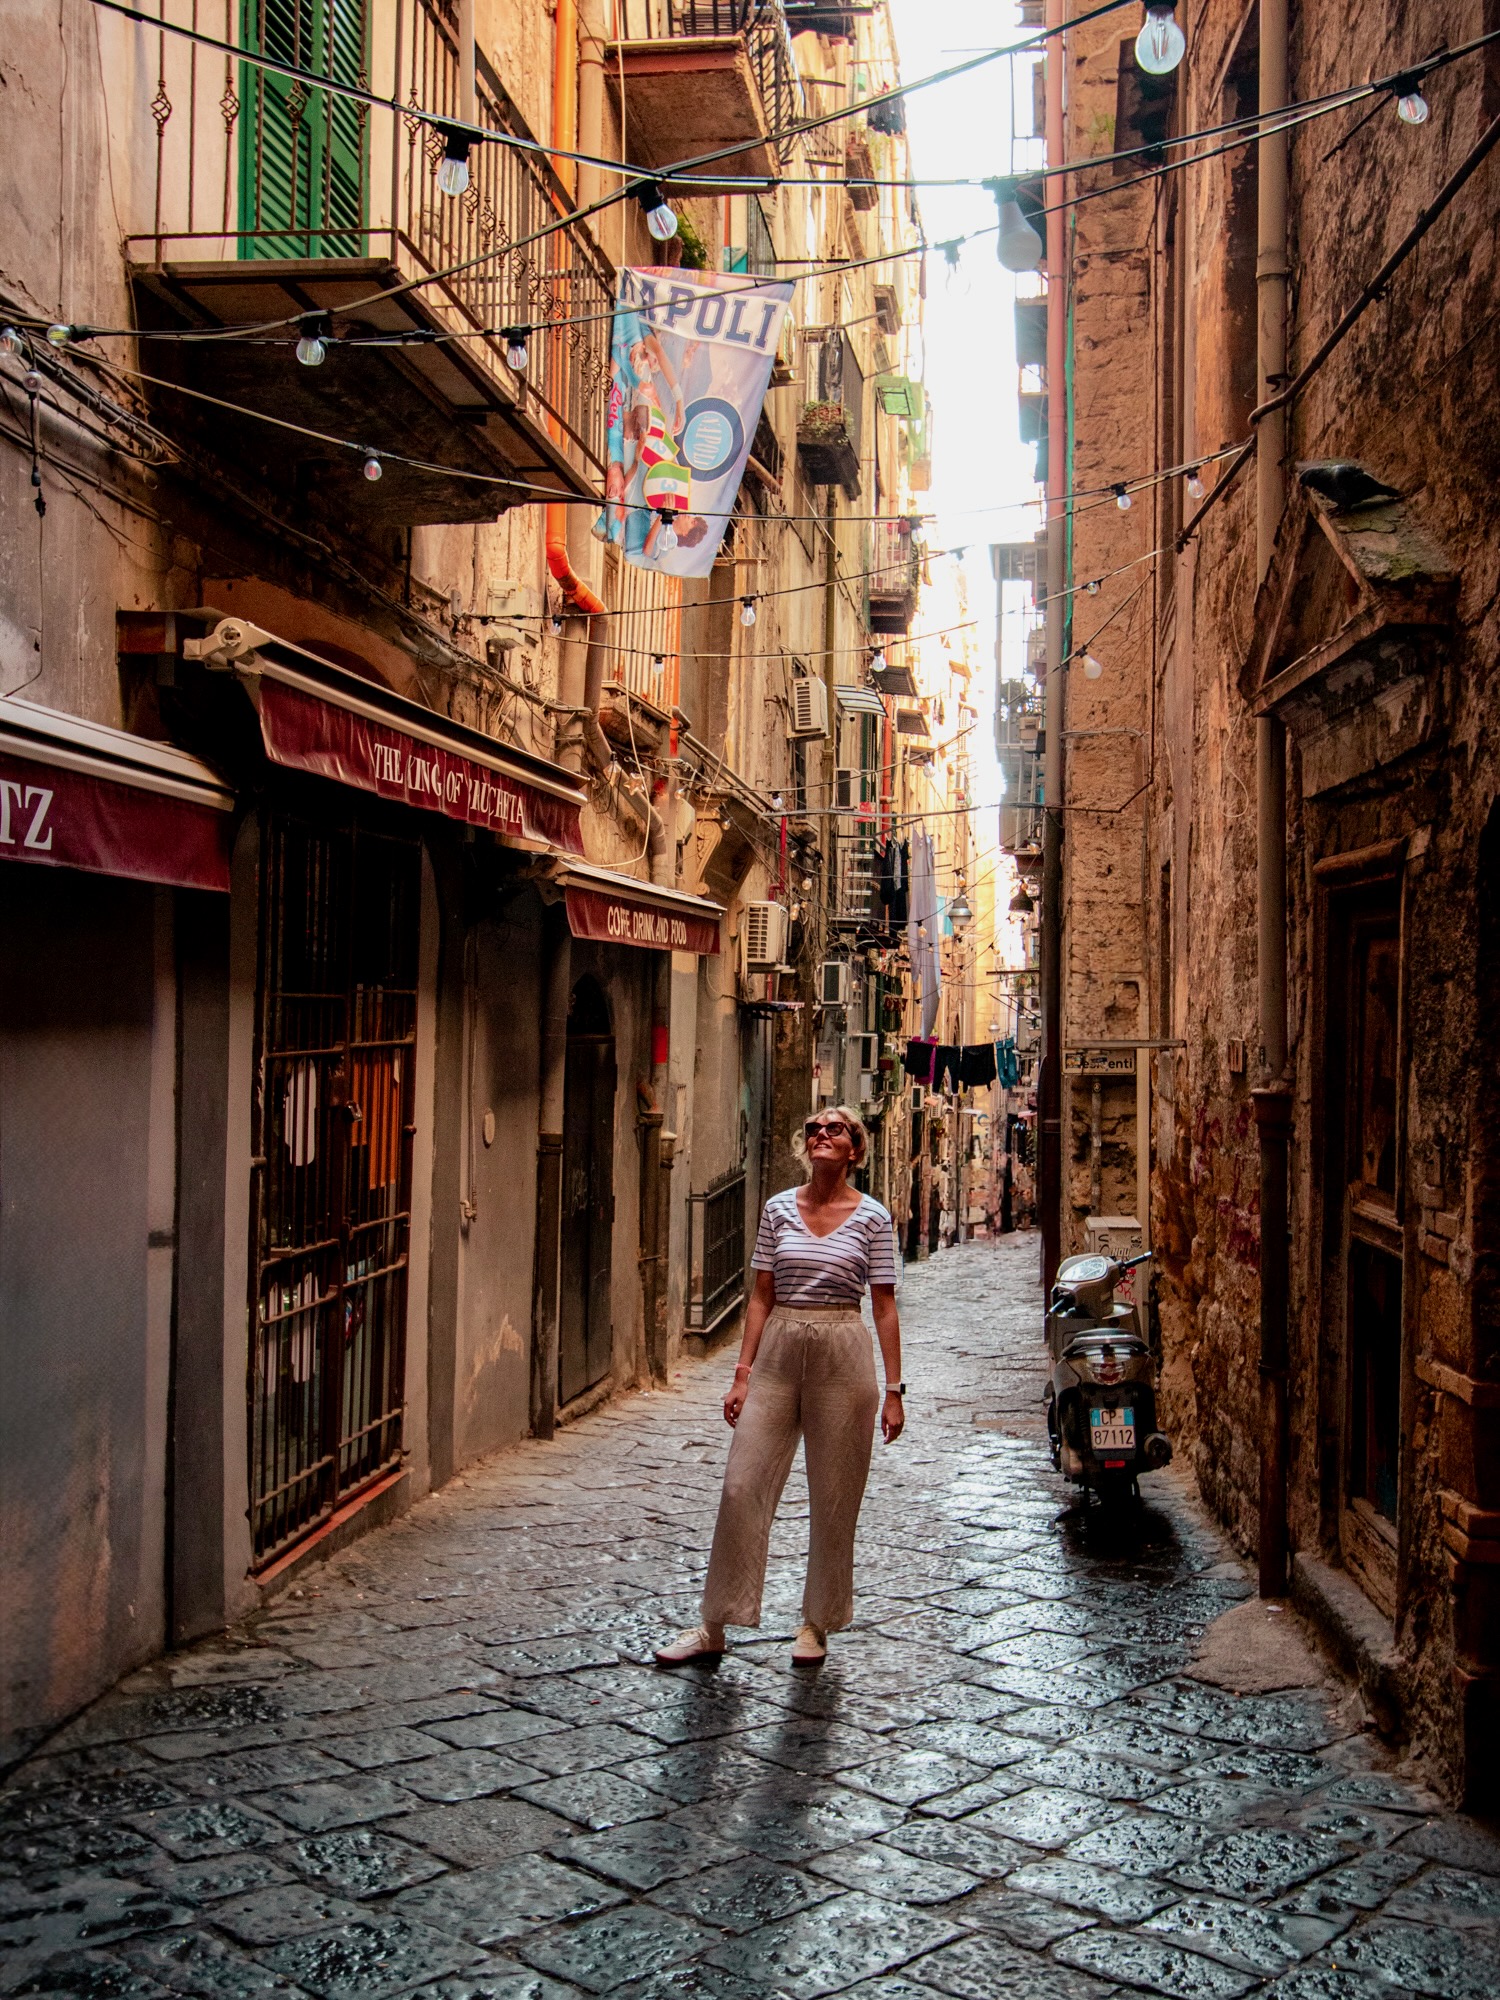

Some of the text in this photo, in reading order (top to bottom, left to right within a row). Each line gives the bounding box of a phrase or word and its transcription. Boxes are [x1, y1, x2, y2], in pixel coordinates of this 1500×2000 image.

[374, 742, 404, 784] THE
[406, 755, 443, 797] KING
[446, 770, 464, 804] OF
[633, 911, 655, 942] DRINK
[655, 916, 669, 944] AND
[671, 919, 687, 945] FOOD
[1101, 1410, 1117, 1425] CP
[1094, 1429, 1134, 1446] 87112
